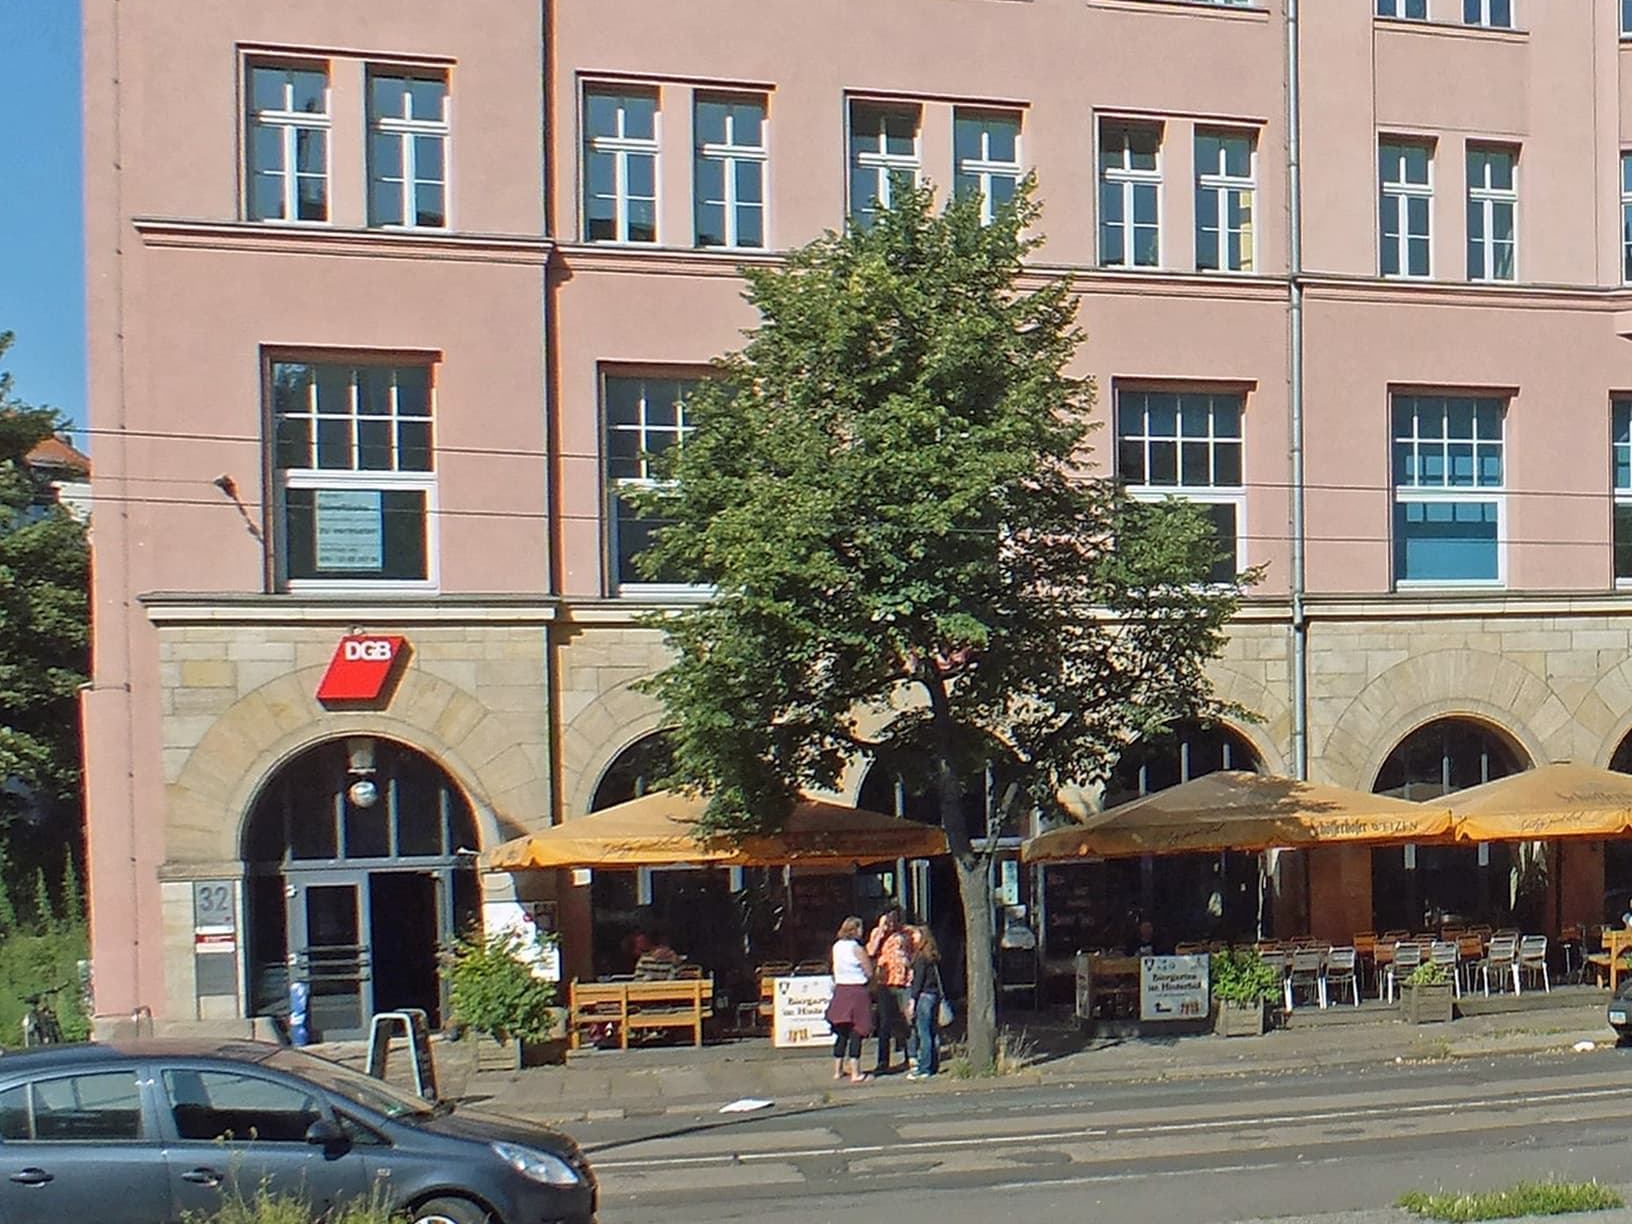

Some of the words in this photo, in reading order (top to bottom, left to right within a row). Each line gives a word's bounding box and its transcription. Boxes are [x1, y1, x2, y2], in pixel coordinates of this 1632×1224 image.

[345, 641, 392, 661] DGB
[1371, 819, 1419, 832] WEIZEN
[199, 886, 229, 912] 32
